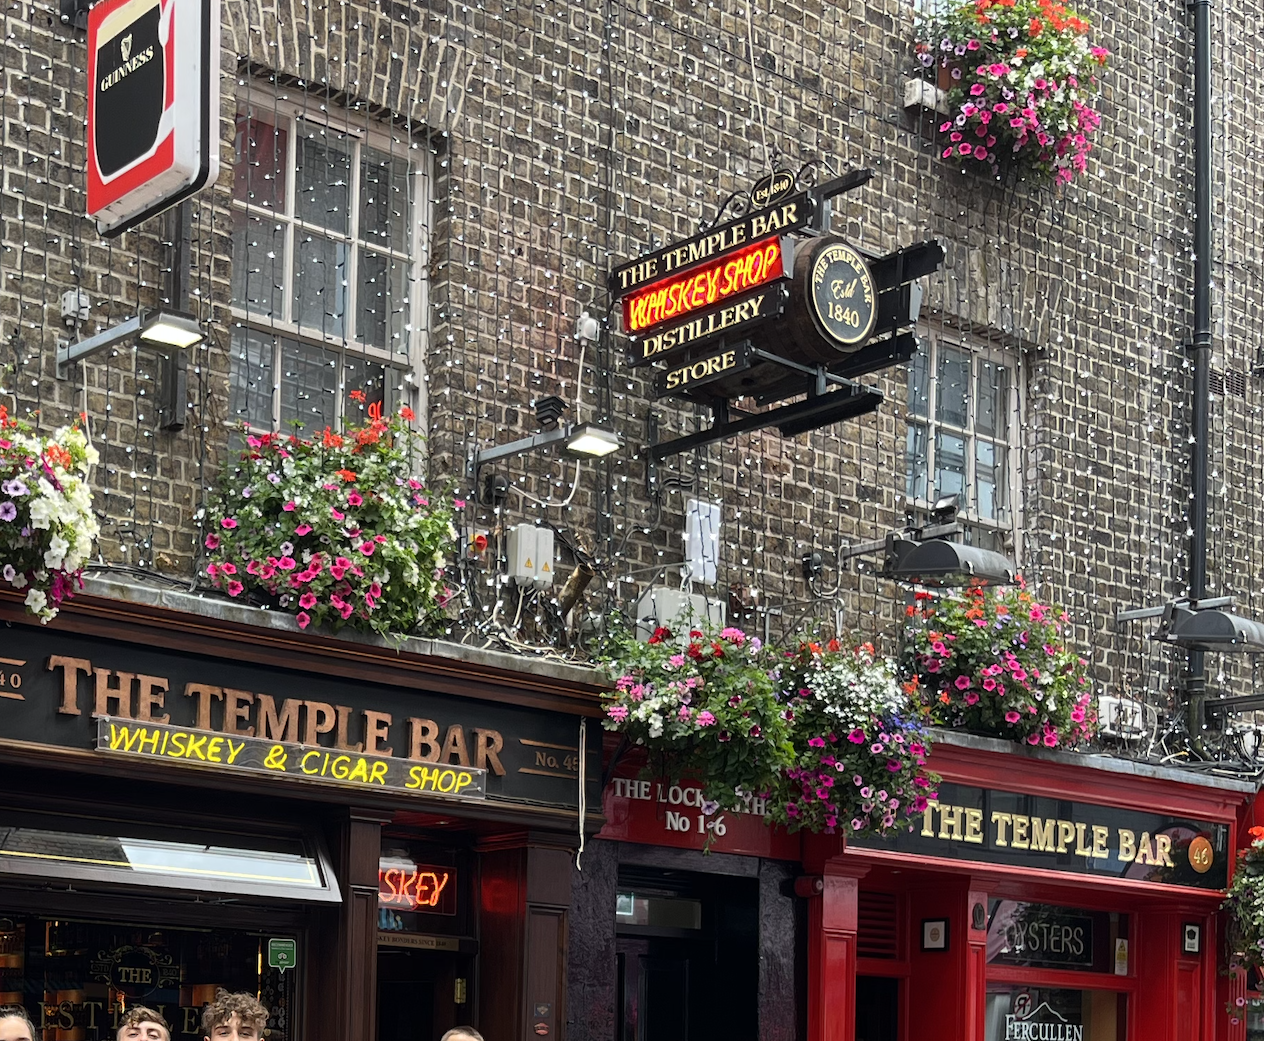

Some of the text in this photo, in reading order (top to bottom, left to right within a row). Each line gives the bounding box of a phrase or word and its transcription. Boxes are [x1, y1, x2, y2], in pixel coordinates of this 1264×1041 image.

[101, 45, 154, 92] GUINNESS
[618, 203, 799, 289] THE TEMPLE BAR
[629, 245, 779, 330] WHISKEY SHOP
[815, 250, 872, 303] THE TEMPLE BAR
[643, 295, 764, 358] DISTILLERY
[828, 302, 859, 328] 1840
[667, 350, 736, 389] STORE
[48, 654, 507, 777] THE TEMPLE BAR
[110, 724, 473, 794] WHISKEY & CIGAR SHOP
[535, 751, 560, 769] No.
[612, 777, 652, 800] THE
[665, 811, 691, 832] No
[920, 798, 1175, 867] THE TEMPLE BAR
[1193, 846, 1209, 866] 46
[378, 868, 449, 907] SKEY
[1003, 919, 1084, 956] OYSTERS
[118, 966, 152, 984] THE
